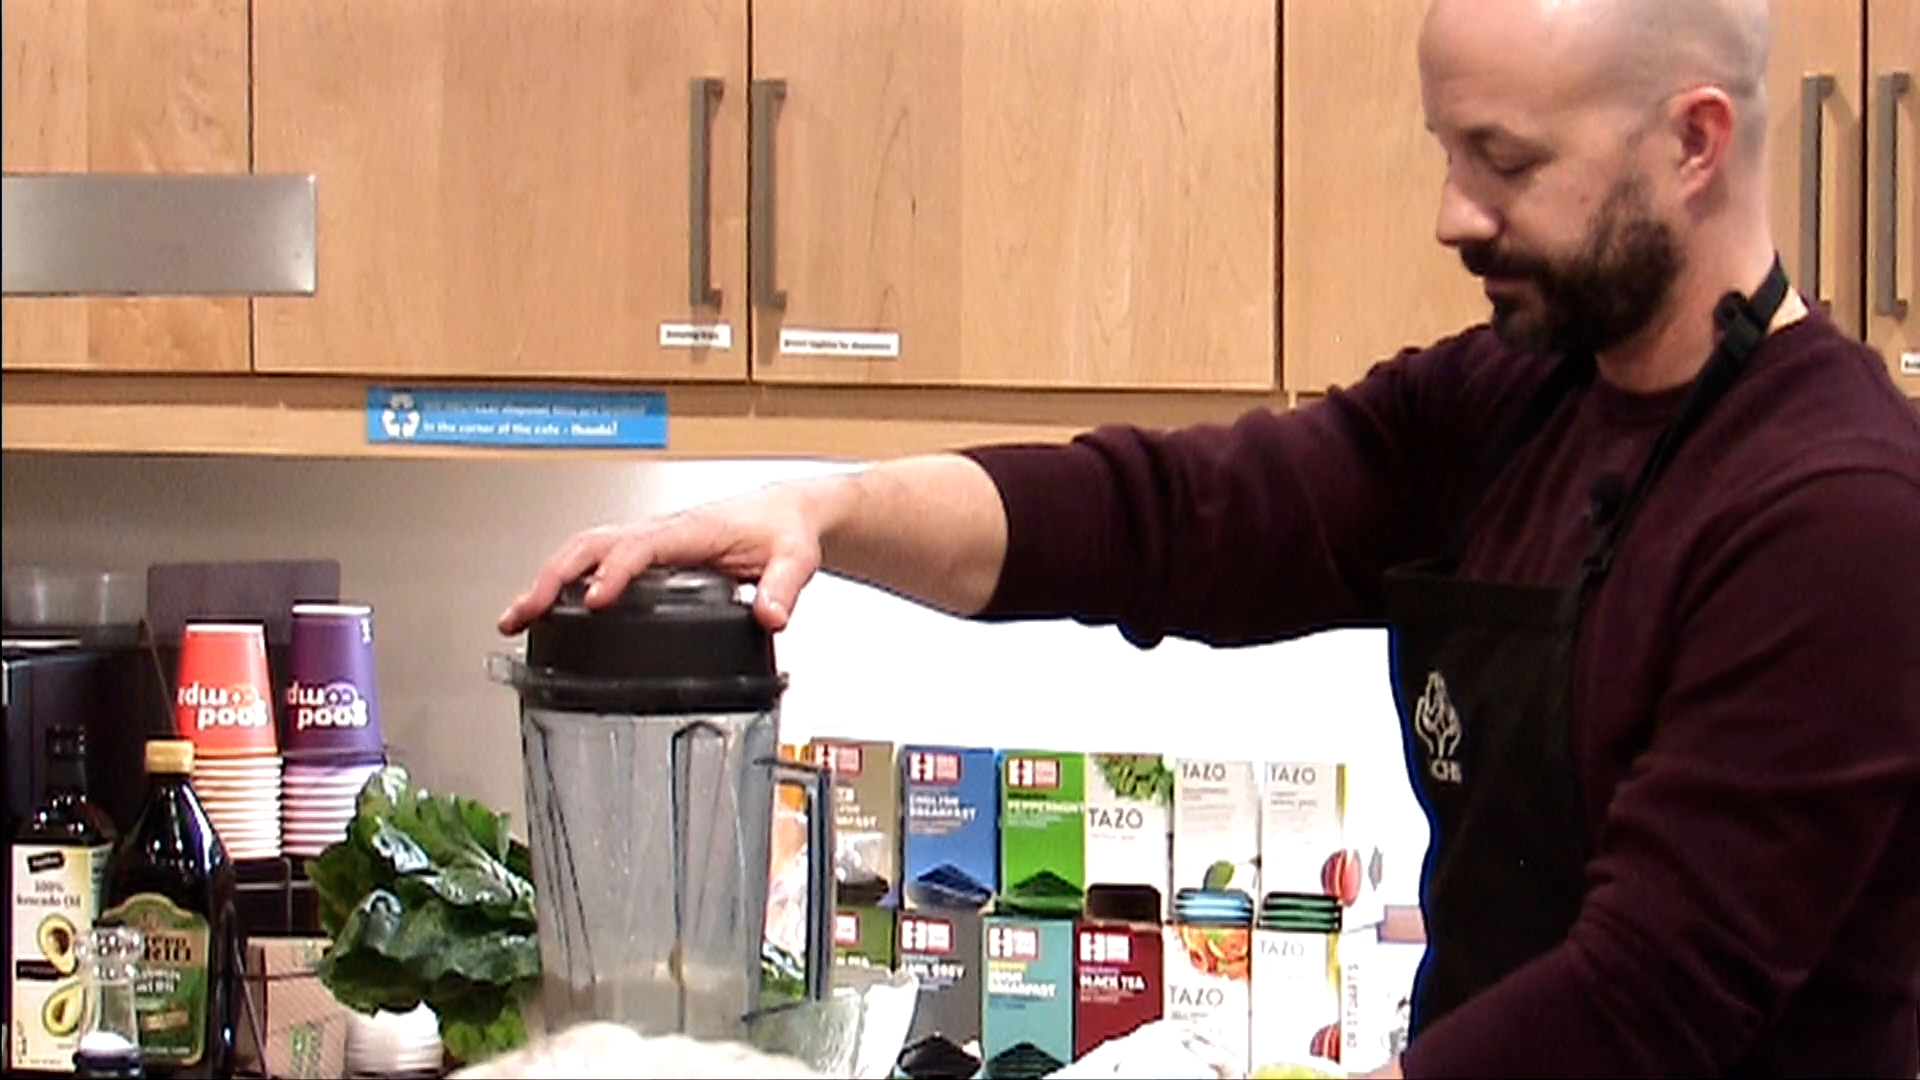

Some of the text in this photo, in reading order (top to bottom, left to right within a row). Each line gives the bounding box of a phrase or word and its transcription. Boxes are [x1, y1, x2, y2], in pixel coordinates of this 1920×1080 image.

[197, 699, 268, 732] good
[297, 699, 368, 731] good
[1182, 763, 1227, 781] TAZO
[1270, 766, 1317, 785] TAZO
[909, 802, 977, 821] BREAKFAST
[1088, 807, 1144, 829] TAZO
[1260, 939, 1305, 958] TAZO
[1121, 975, 1145, 991] TEA
[1168, 984, 1225, 1006] TAZO
